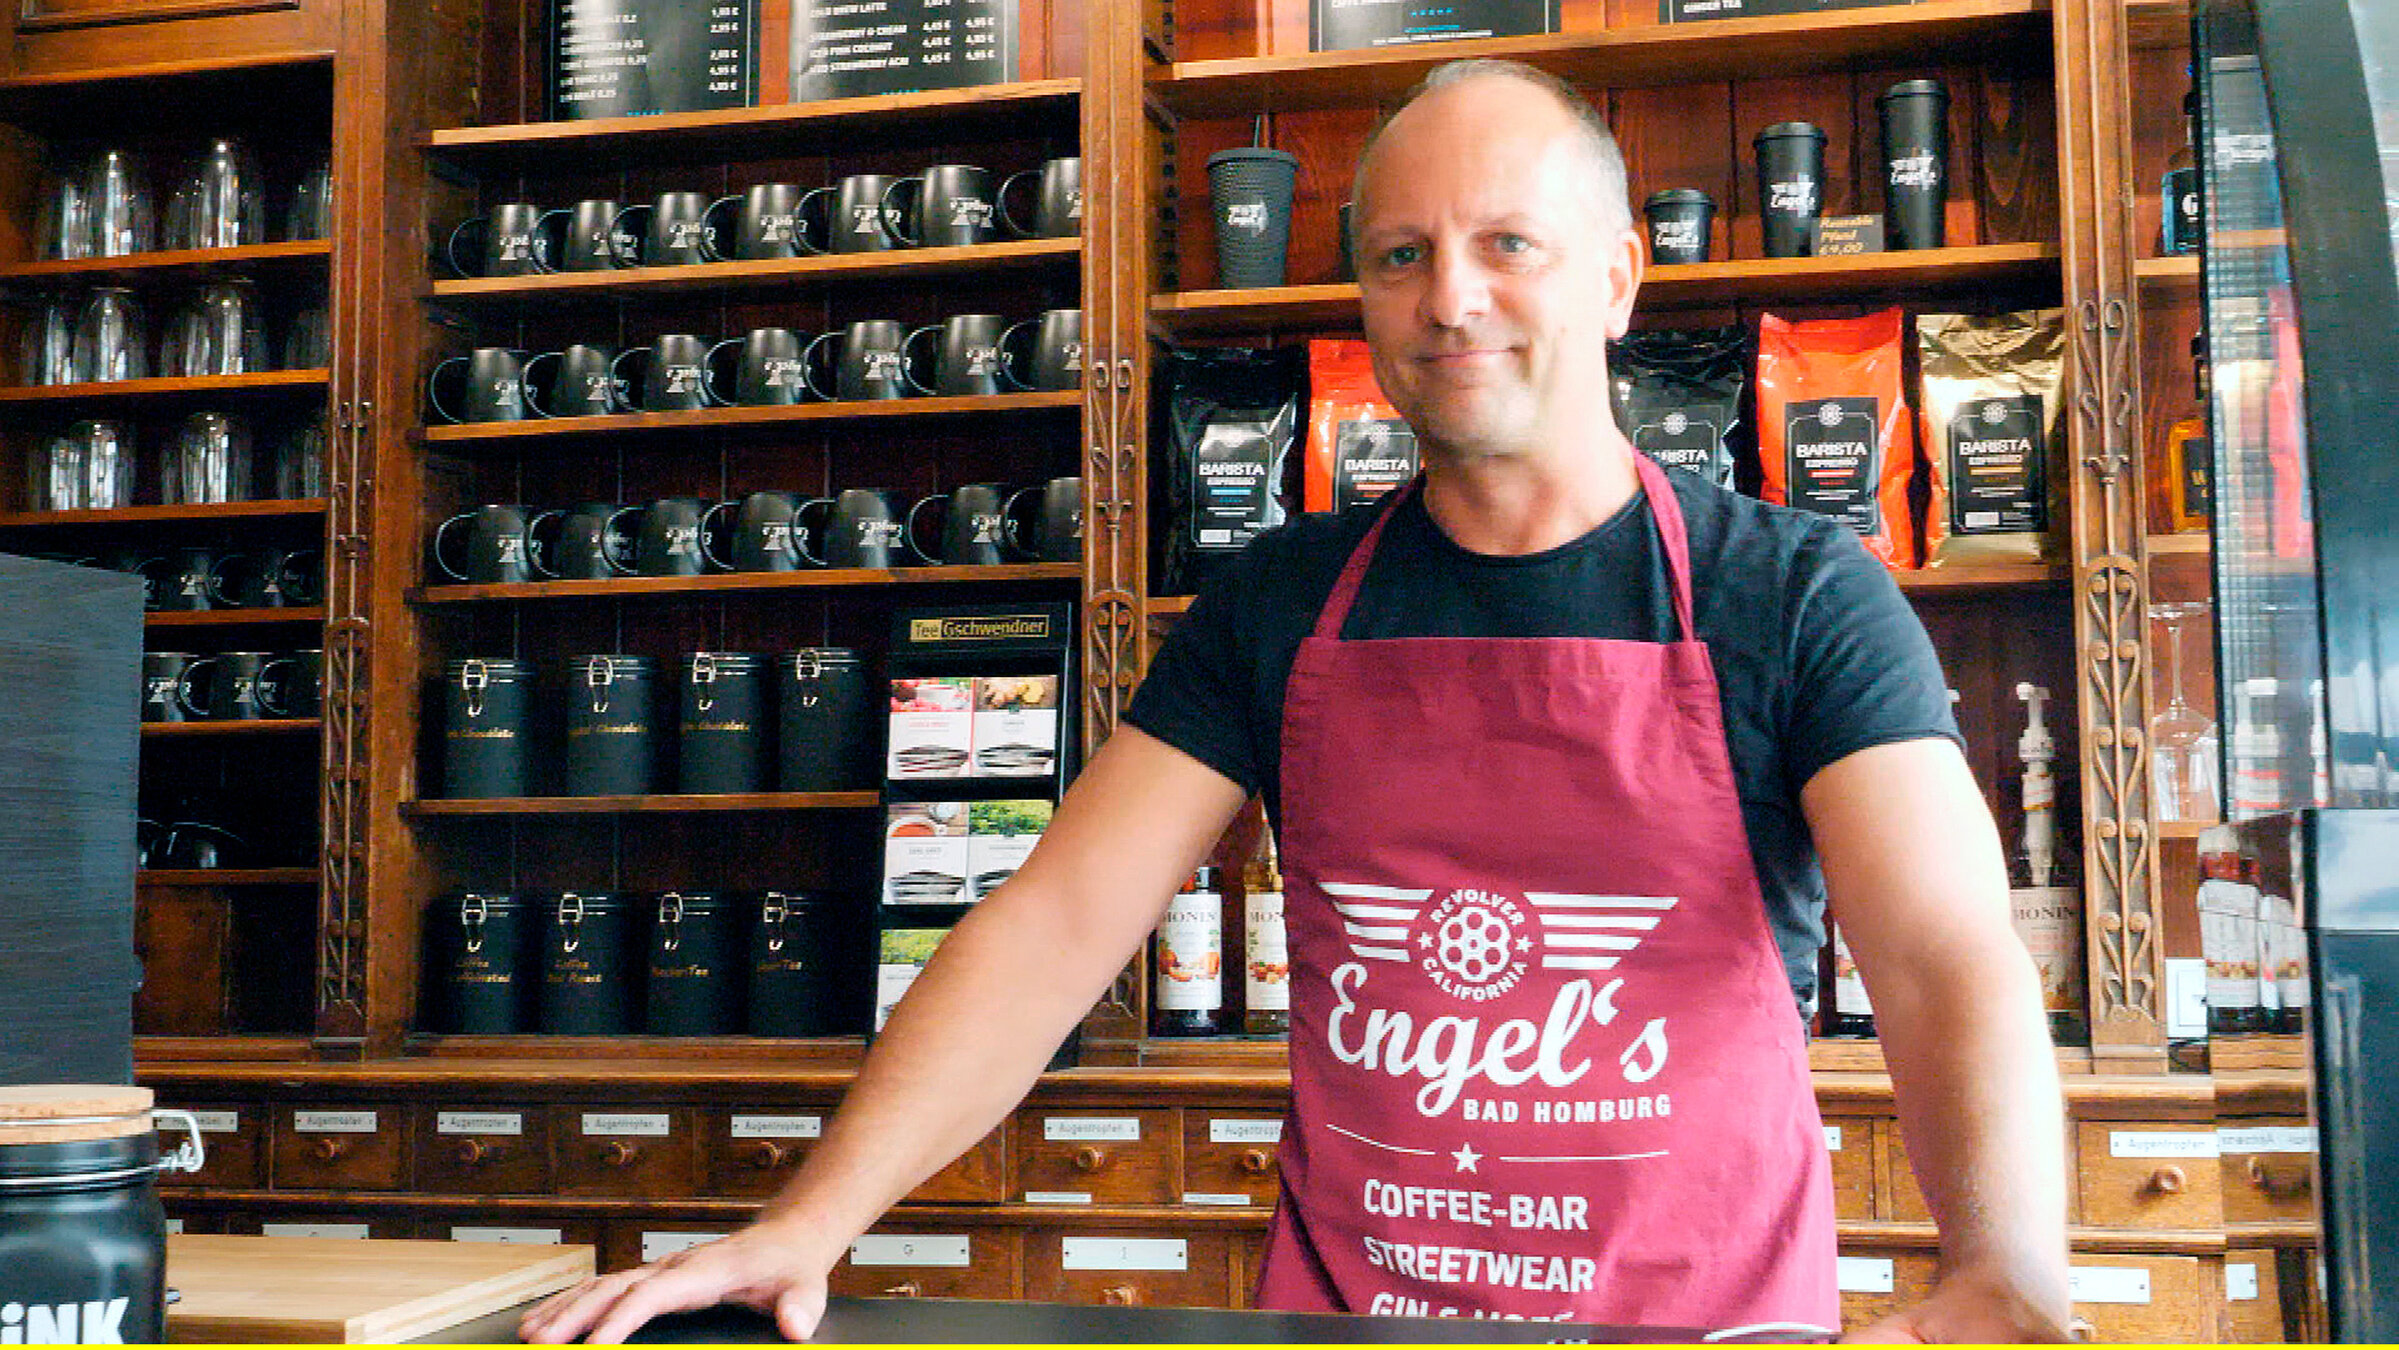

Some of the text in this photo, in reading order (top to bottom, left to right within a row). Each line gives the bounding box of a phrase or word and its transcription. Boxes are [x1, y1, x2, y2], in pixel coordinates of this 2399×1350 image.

[1796, 441, 1868, 458] BARISTA
[1959, 437, 2033, 456] BARISTA
[1199, 463, 1265, 476] BARISTA
[1344, 458, 1410, 472] BARISTA
[914, 619, 1045, 638] Tee Gschwendner
[1430, 889, 1526, 926] REVOLVER
[1422, 957, 1529, 1002] CALIFORNIA
[1463, 1094, 1672, 1122] BAD HOMBURG
[1363, 1177, 1589, 1231] COFFEE-BAR
[1363, 1235, 1597, 1293] STREETWEAR
[1370, 1291, 1430, 1317] GIN
